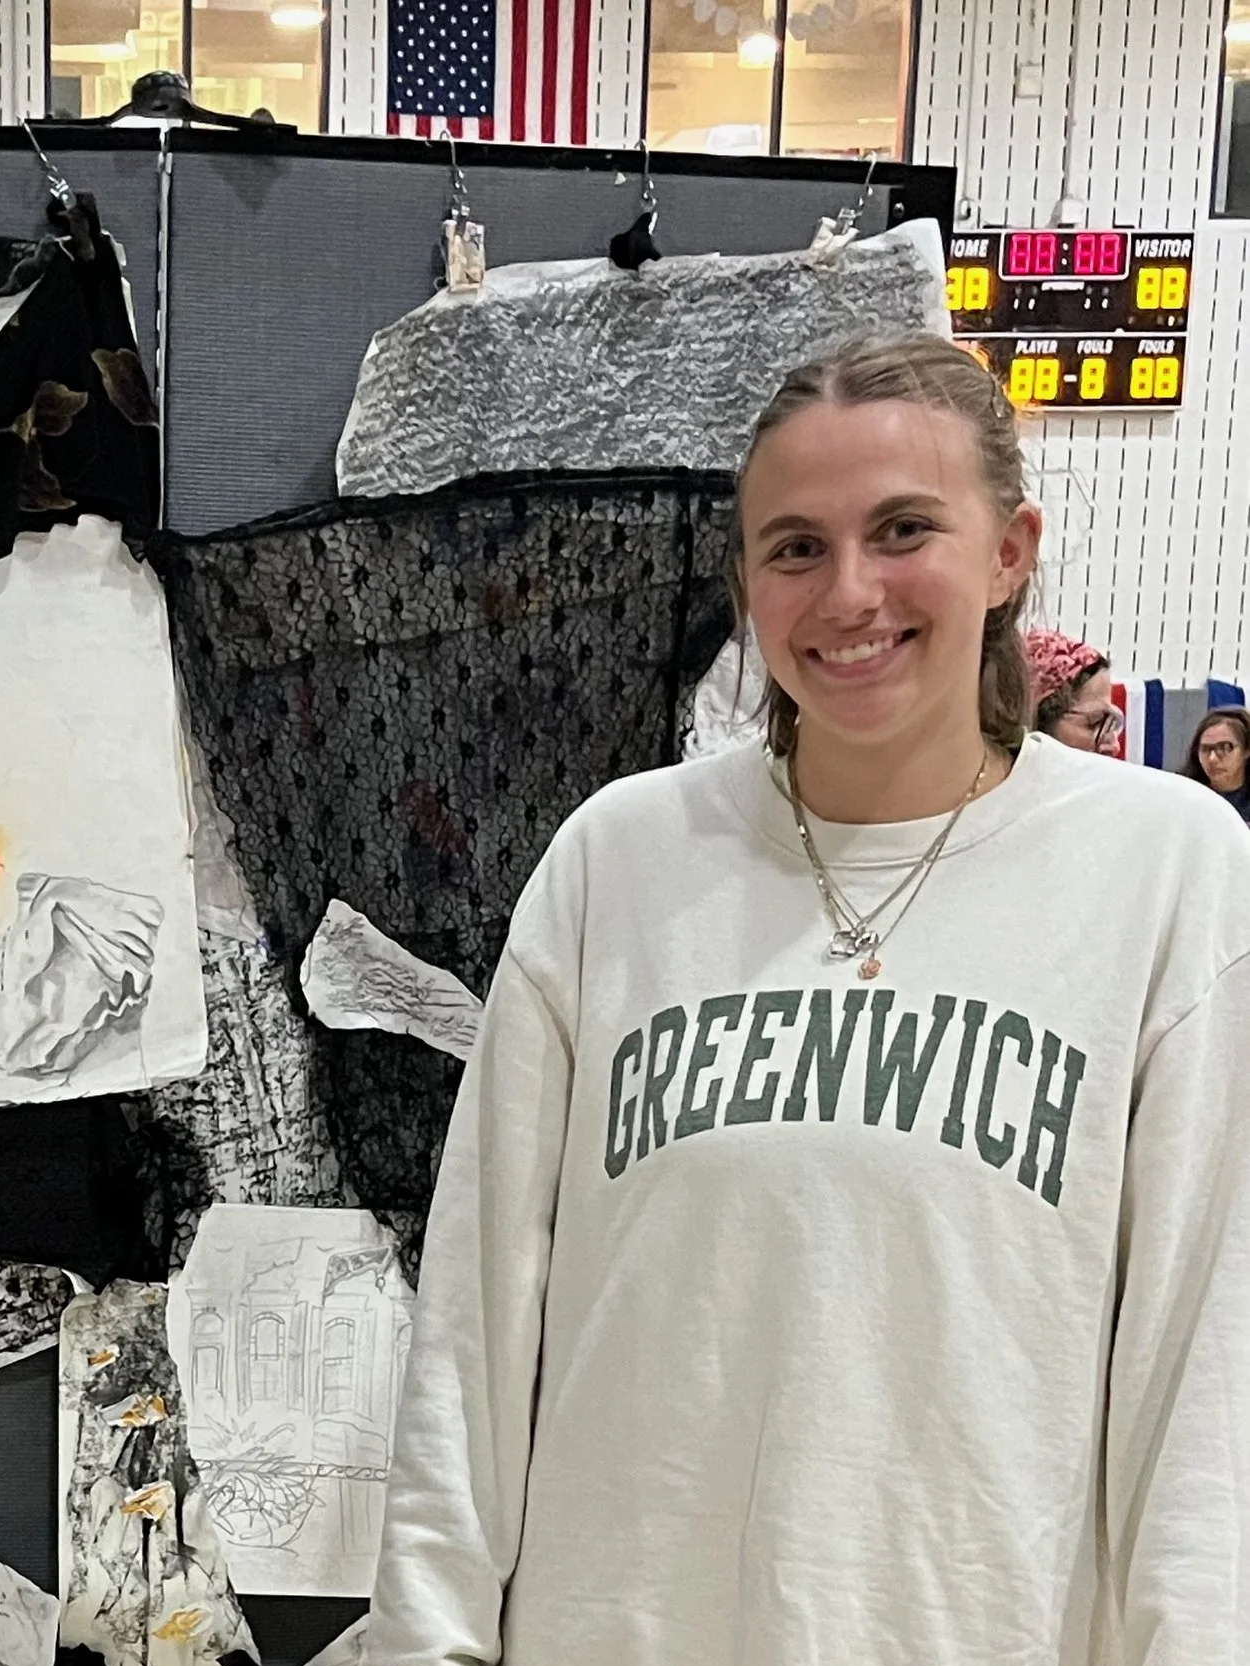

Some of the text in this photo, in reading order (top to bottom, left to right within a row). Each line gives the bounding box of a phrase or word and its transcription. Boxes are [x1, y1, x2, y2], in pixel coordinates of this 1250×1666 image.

[1135, 239, 1192, 258] VISITOR
[1015, 340, 1058, 354] PLAYER
[1077, 340, 1113, 354] FOULS
[1138, 340, 1175, 354] FOULS
[603, 988, 1086, 1208] GREENWICH
